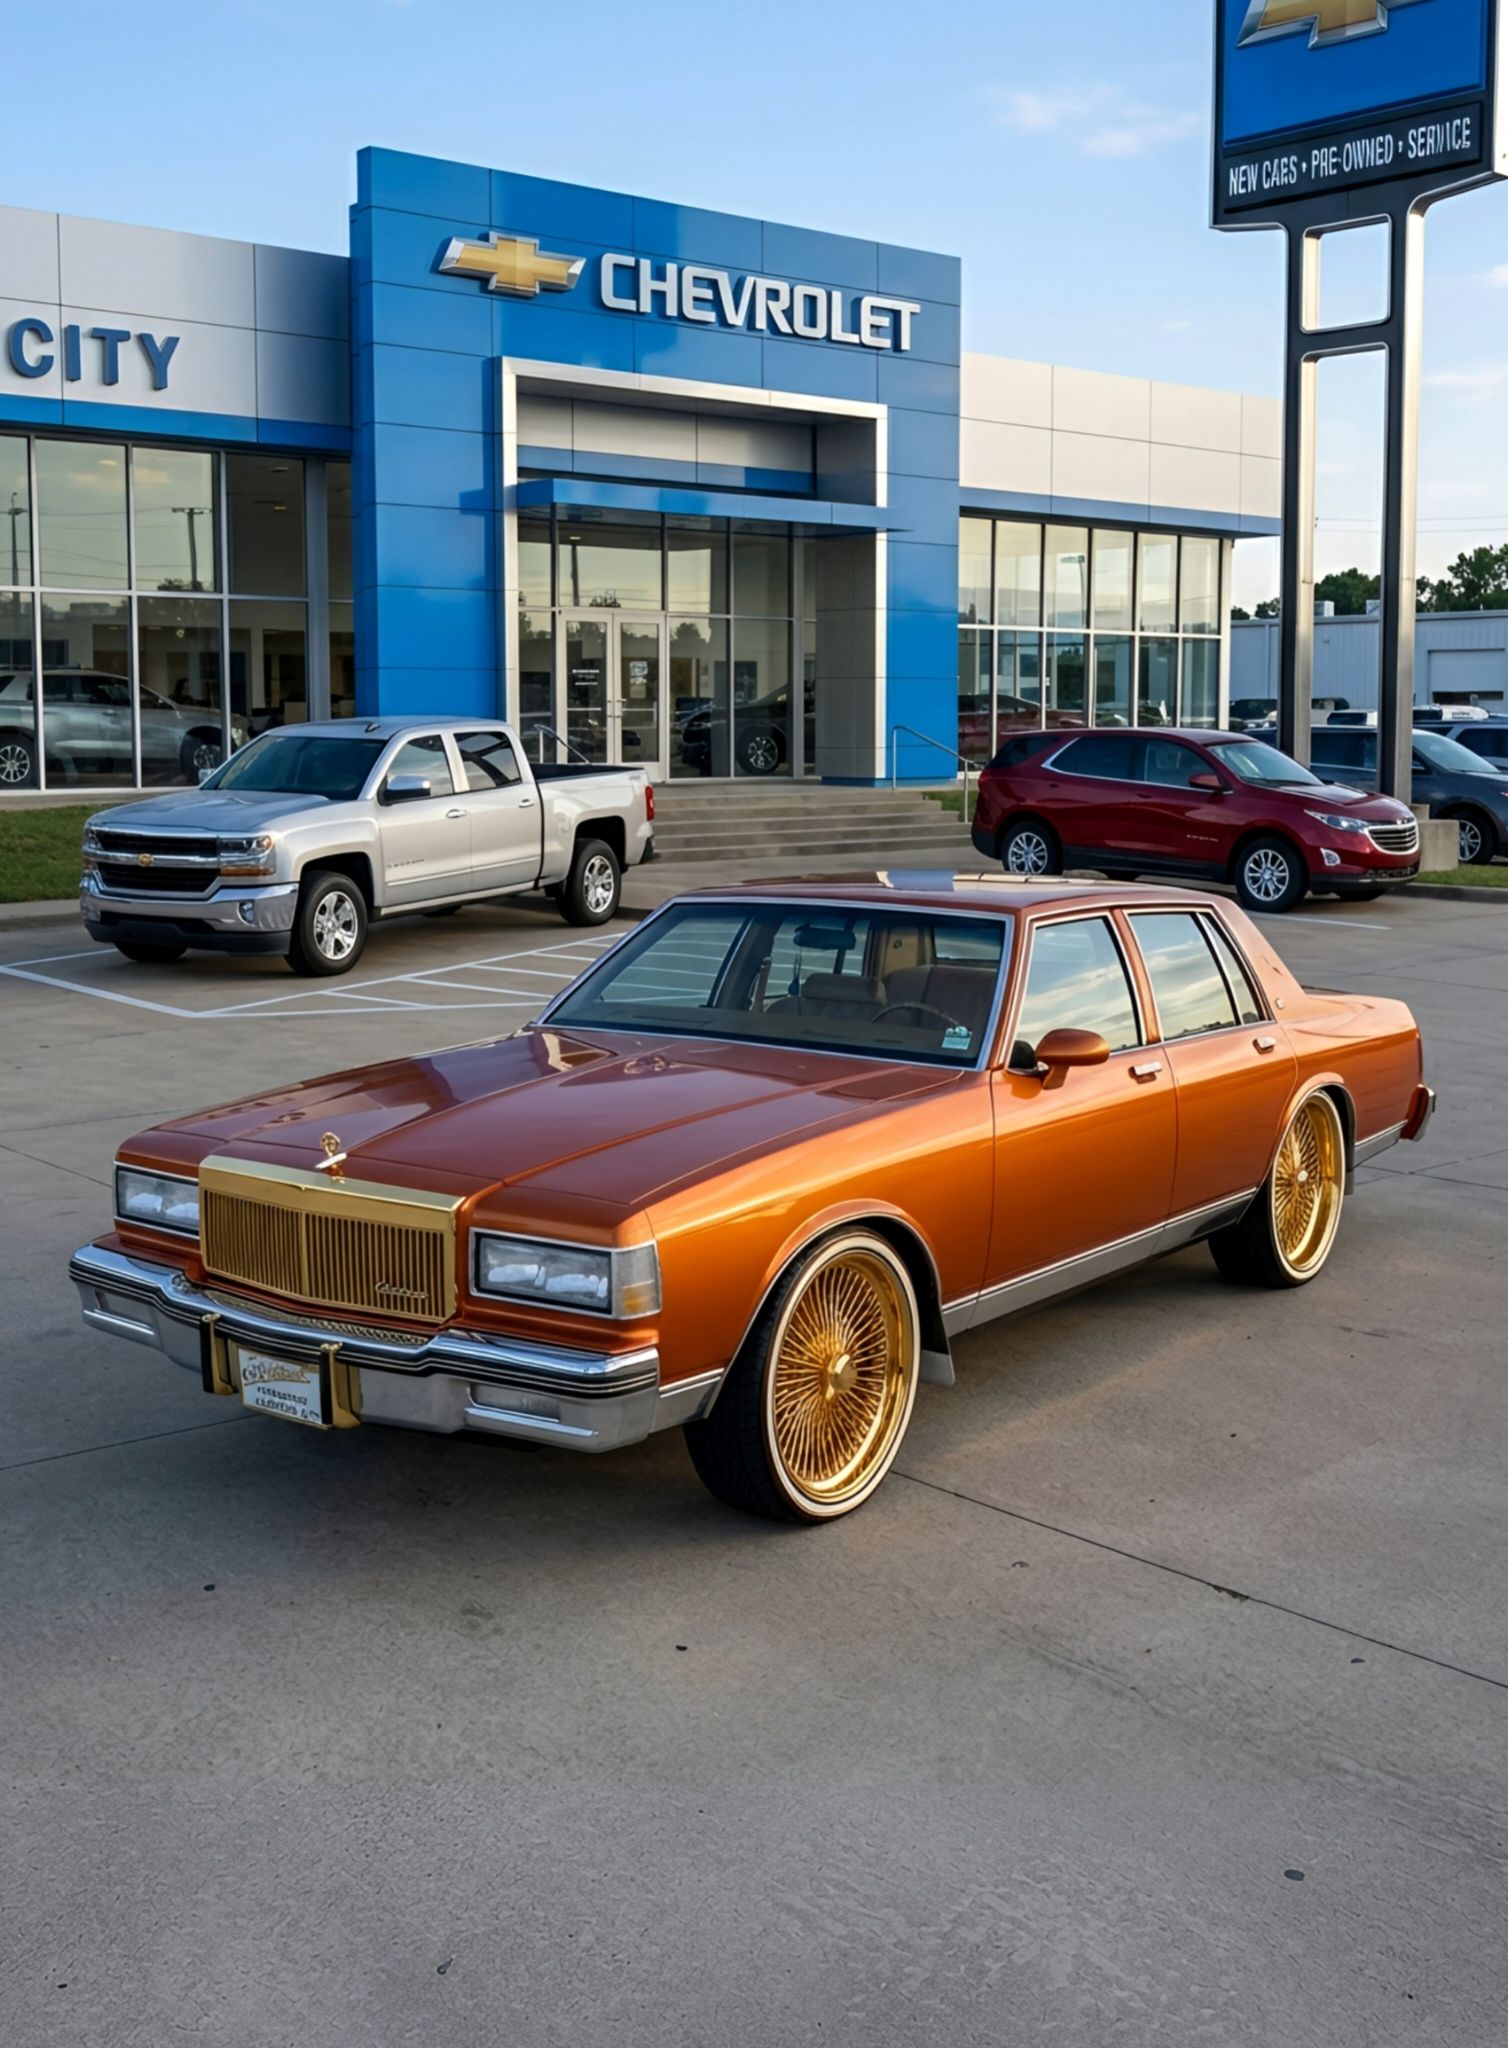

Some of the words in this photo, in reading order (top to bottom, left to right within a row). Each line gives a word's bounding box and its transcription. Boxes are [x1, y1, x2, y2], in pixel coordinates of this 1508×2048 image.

[1228, 163, 1259, 197] NEW
[1262, 155, 1298, 189] CARS
[1311, 134, 1394, 180] PRE-OWNED
[601, 252, 921, 351] CHEVROLET
[8, 317, 181, 391] CITY
